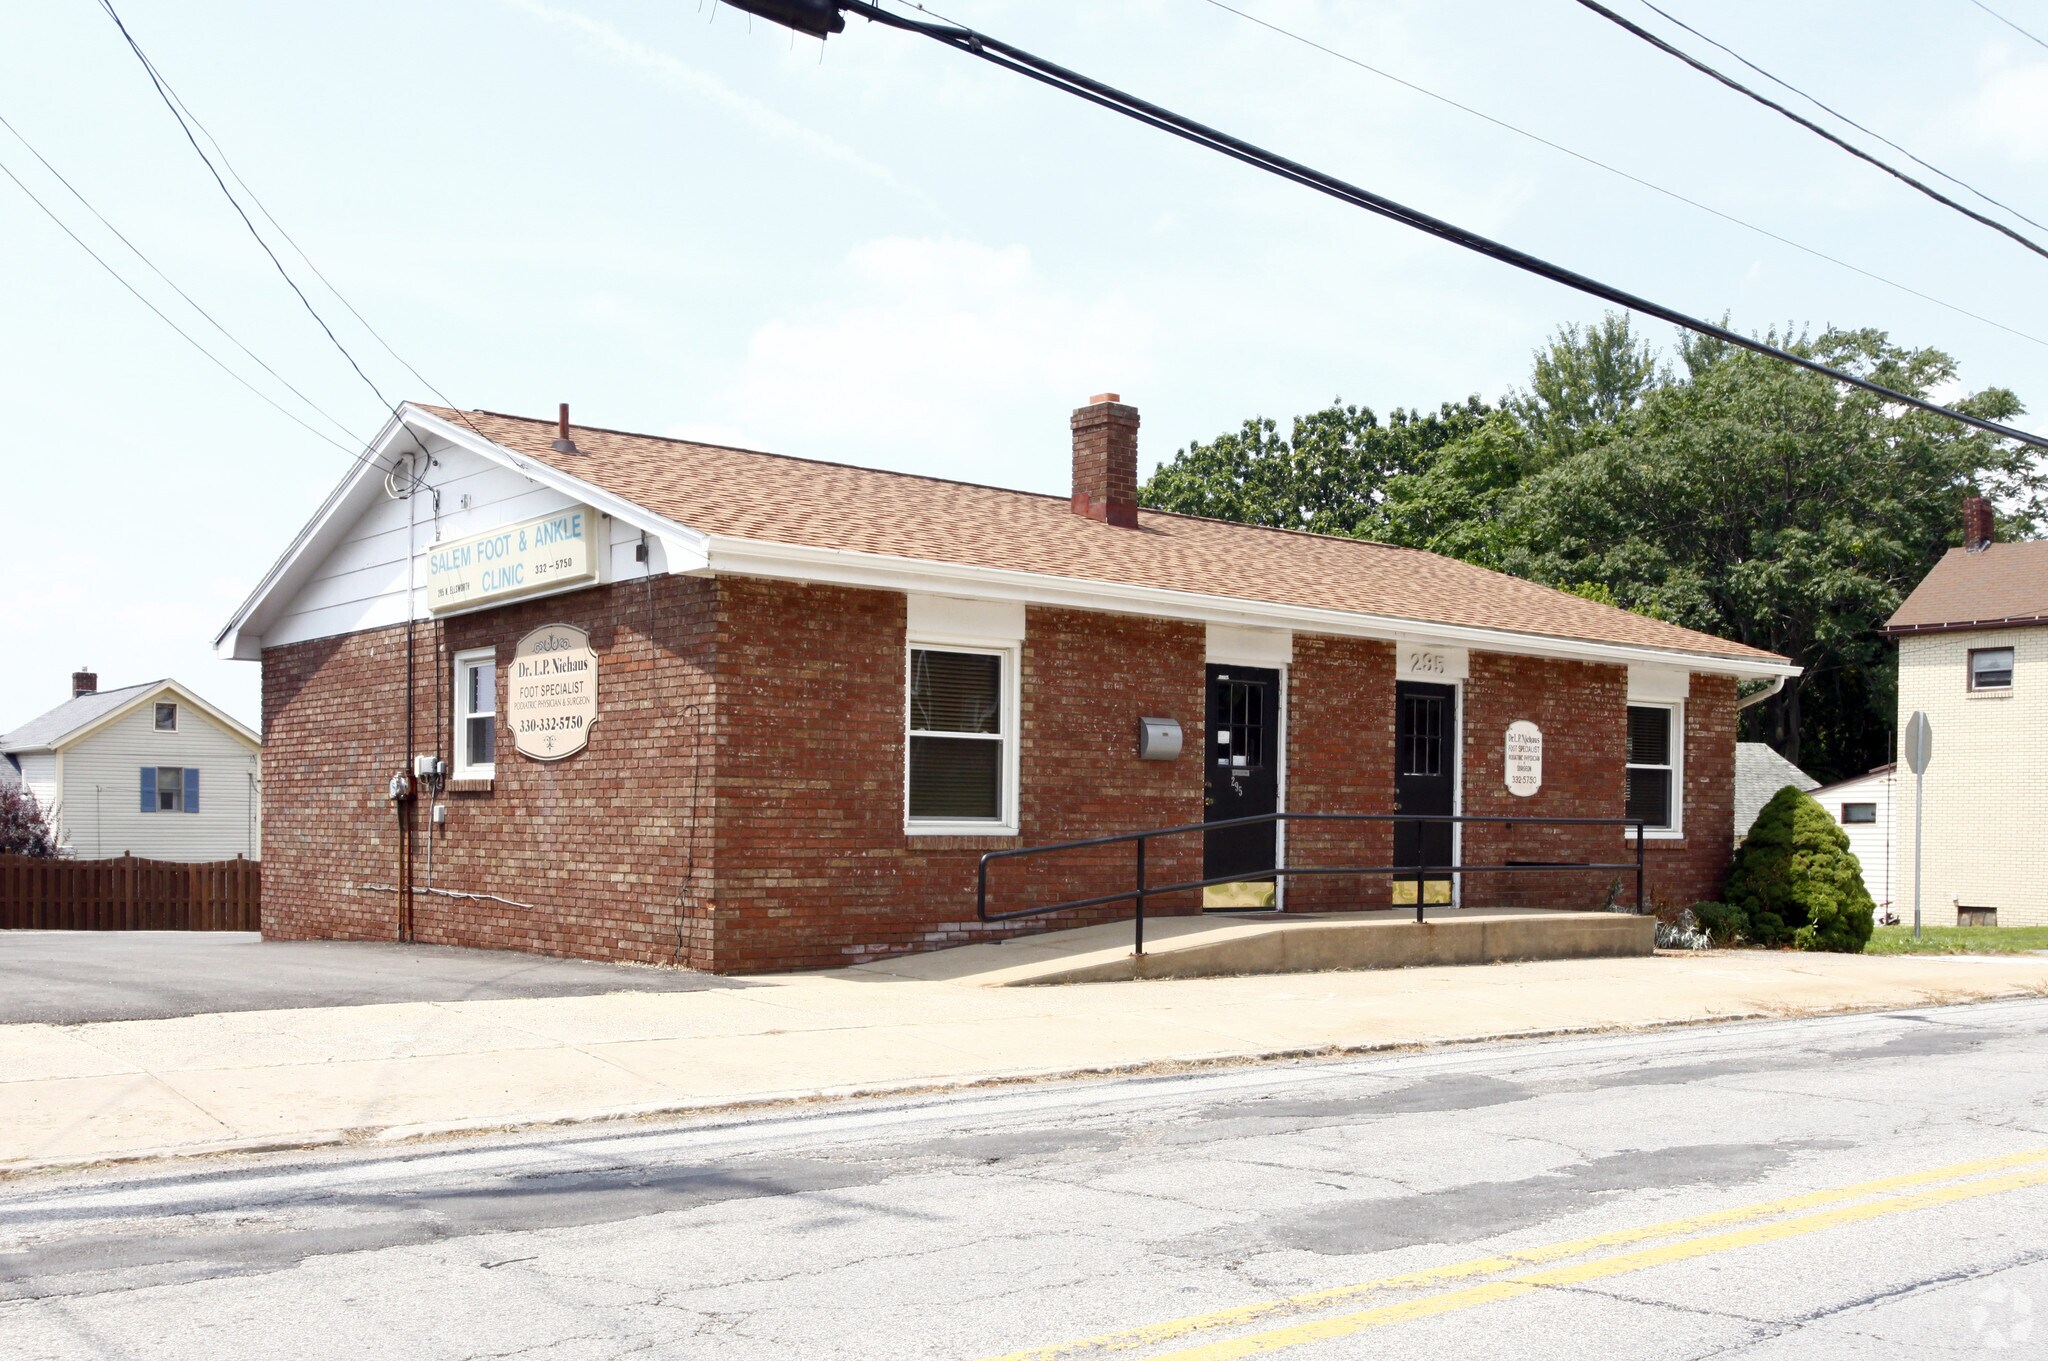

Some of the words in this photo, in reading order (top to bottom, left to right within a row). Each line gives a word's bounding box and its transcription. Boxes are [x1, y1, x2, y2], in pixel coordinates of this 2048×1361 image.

[431, 545, 471, 575] SALEM
[477, 534, 511, 563] FOOT
[519, 529, 527, 553] &
[535, 513, 582, 548] ANKLE
[482, 563, 524, 592] CLINIC
[518, 662, 532, 678] Dr.
[552, 656, 588, 674] Niehaus
[520, 685, 539, 698] FOOT
[541, 680, 584, 697] SPECIALIST
[514, 700, 537, 710] PODIATRIC
[538, 698, 561, 708] PHYSICIAN
[567, 696, 591, 706] SURGEON
[1231, 776, 1243, 797] 295
